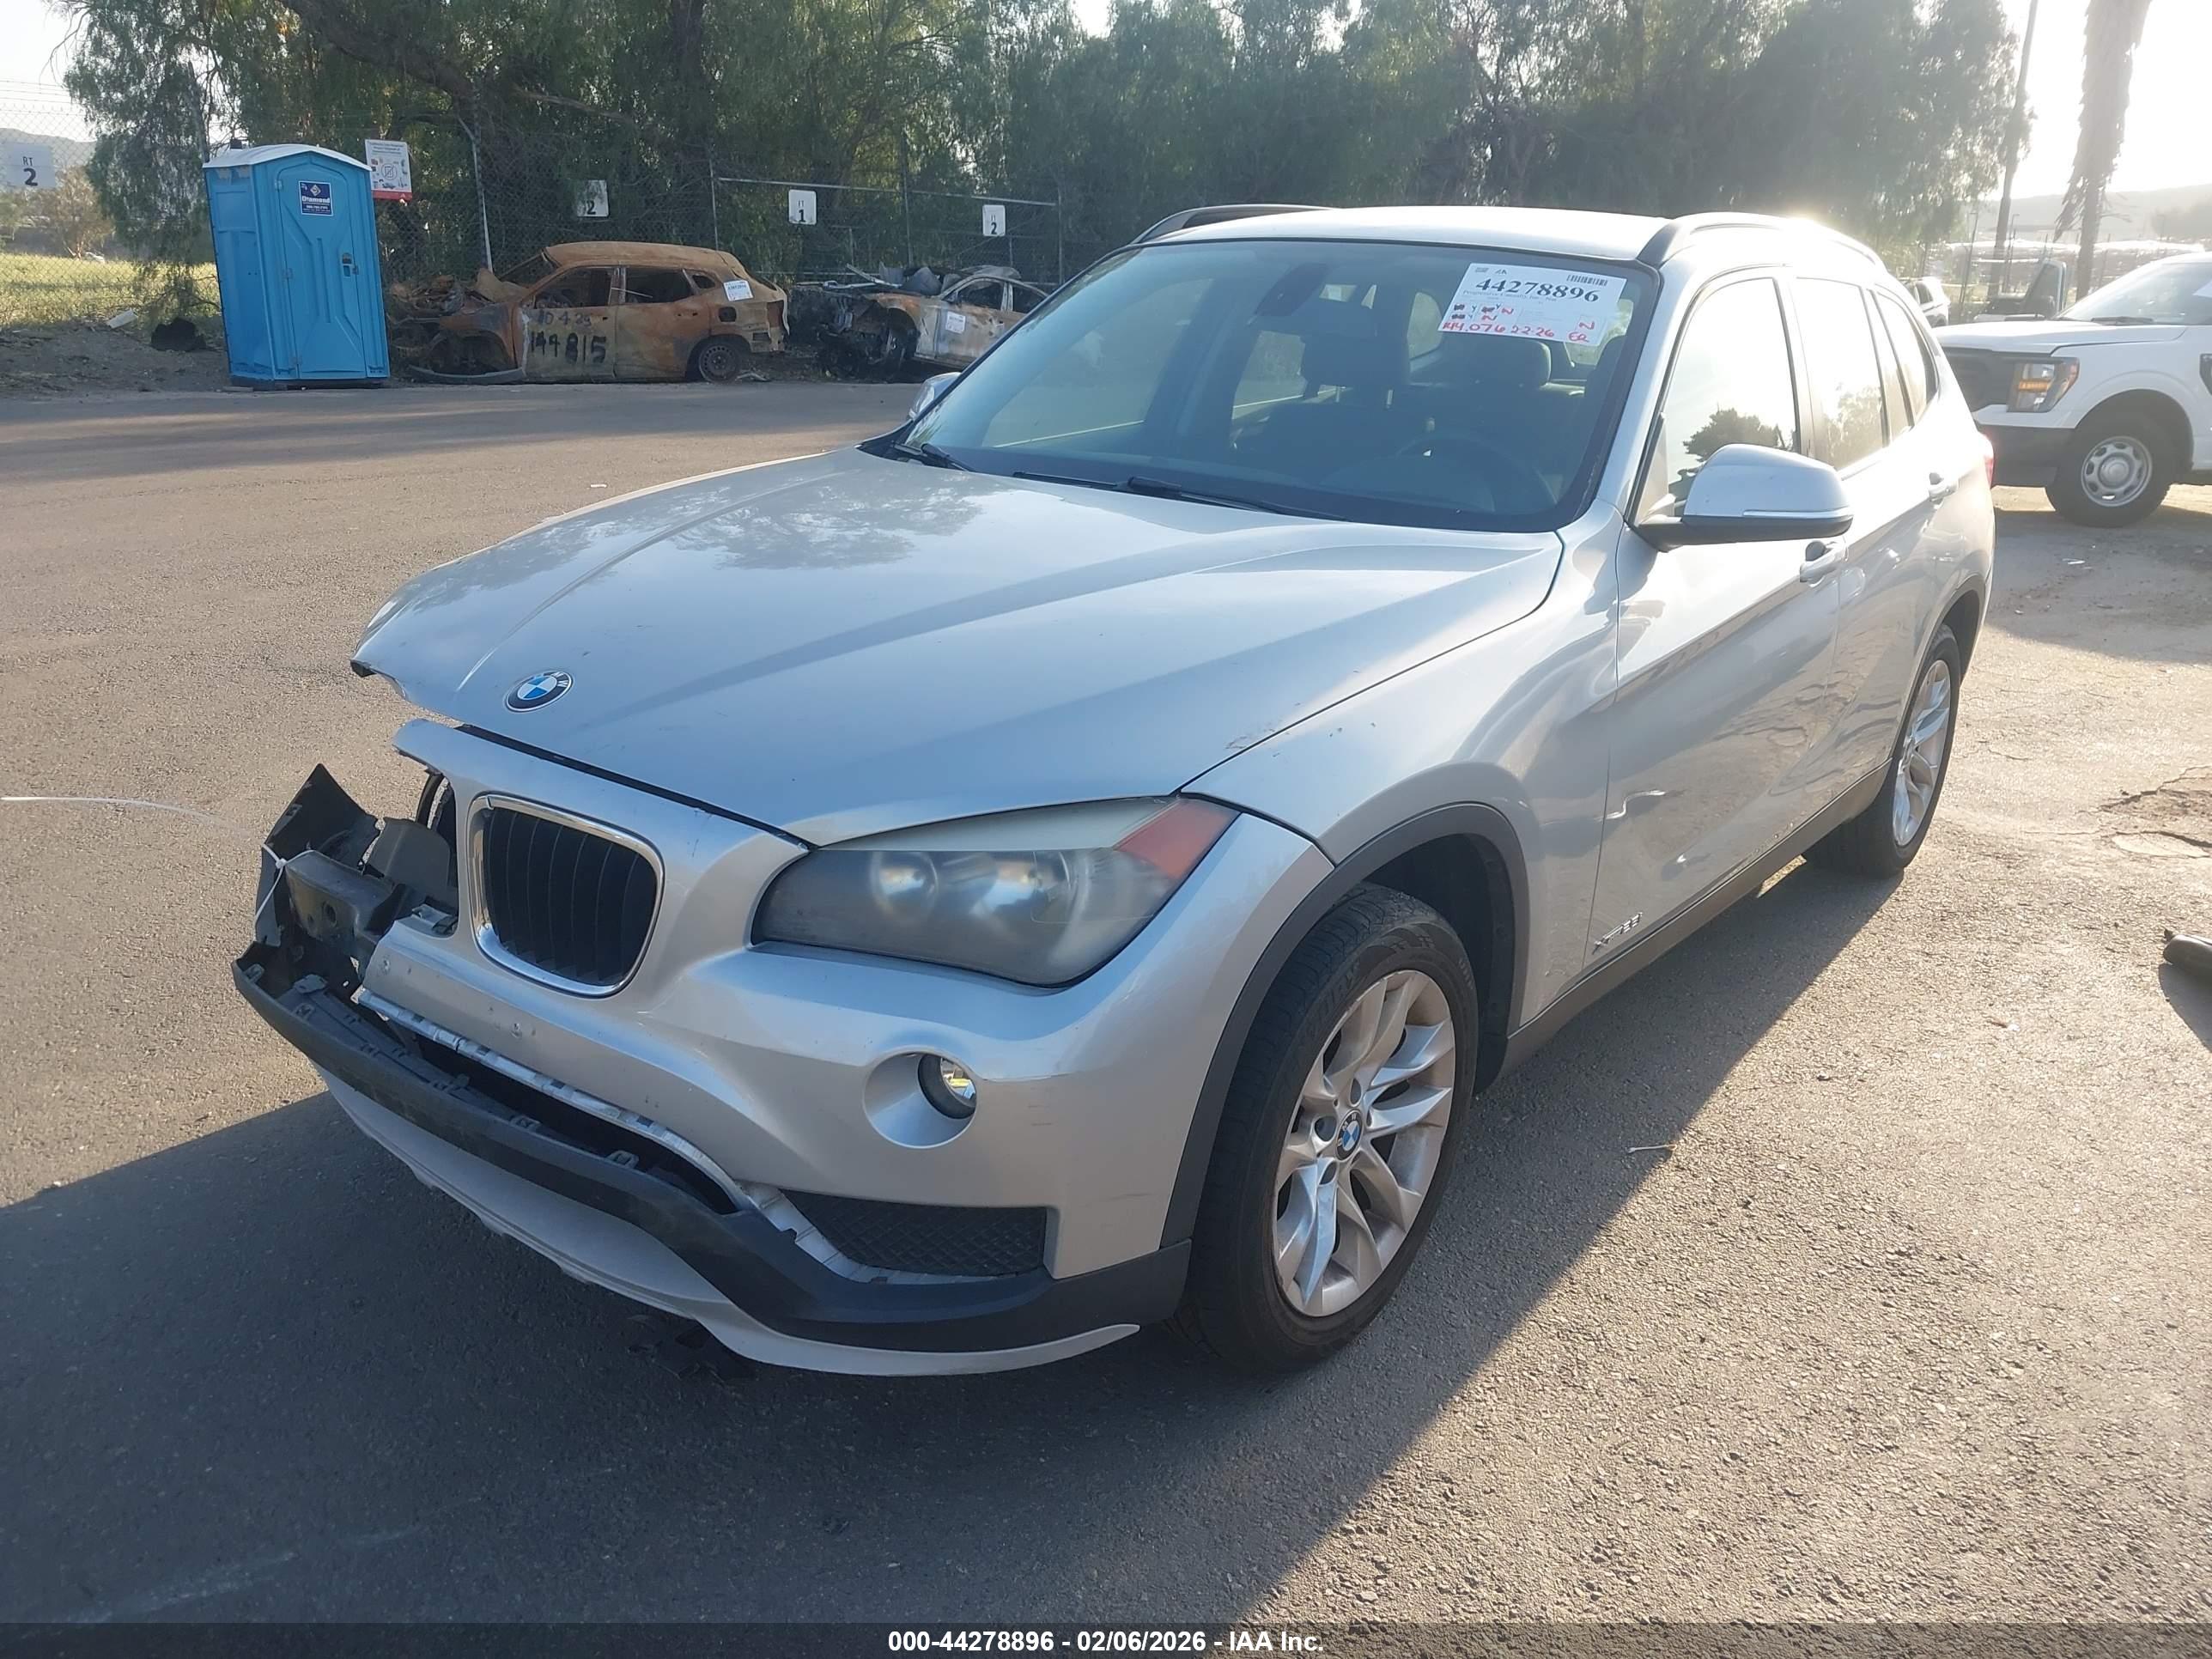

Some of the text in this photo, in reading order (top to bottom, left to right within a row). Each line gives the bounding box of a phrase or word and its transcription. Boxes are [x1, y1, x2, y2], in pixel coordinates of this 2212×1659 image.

[22, 156, 33, 167] RT
[24, 167, 38, 186] 2
[586, 199, 596, 215] 2
[799, 210, 806, 222] 1
[991, 222, 997, 234] 2
[1476, 279, 1601, 302] 44278896
